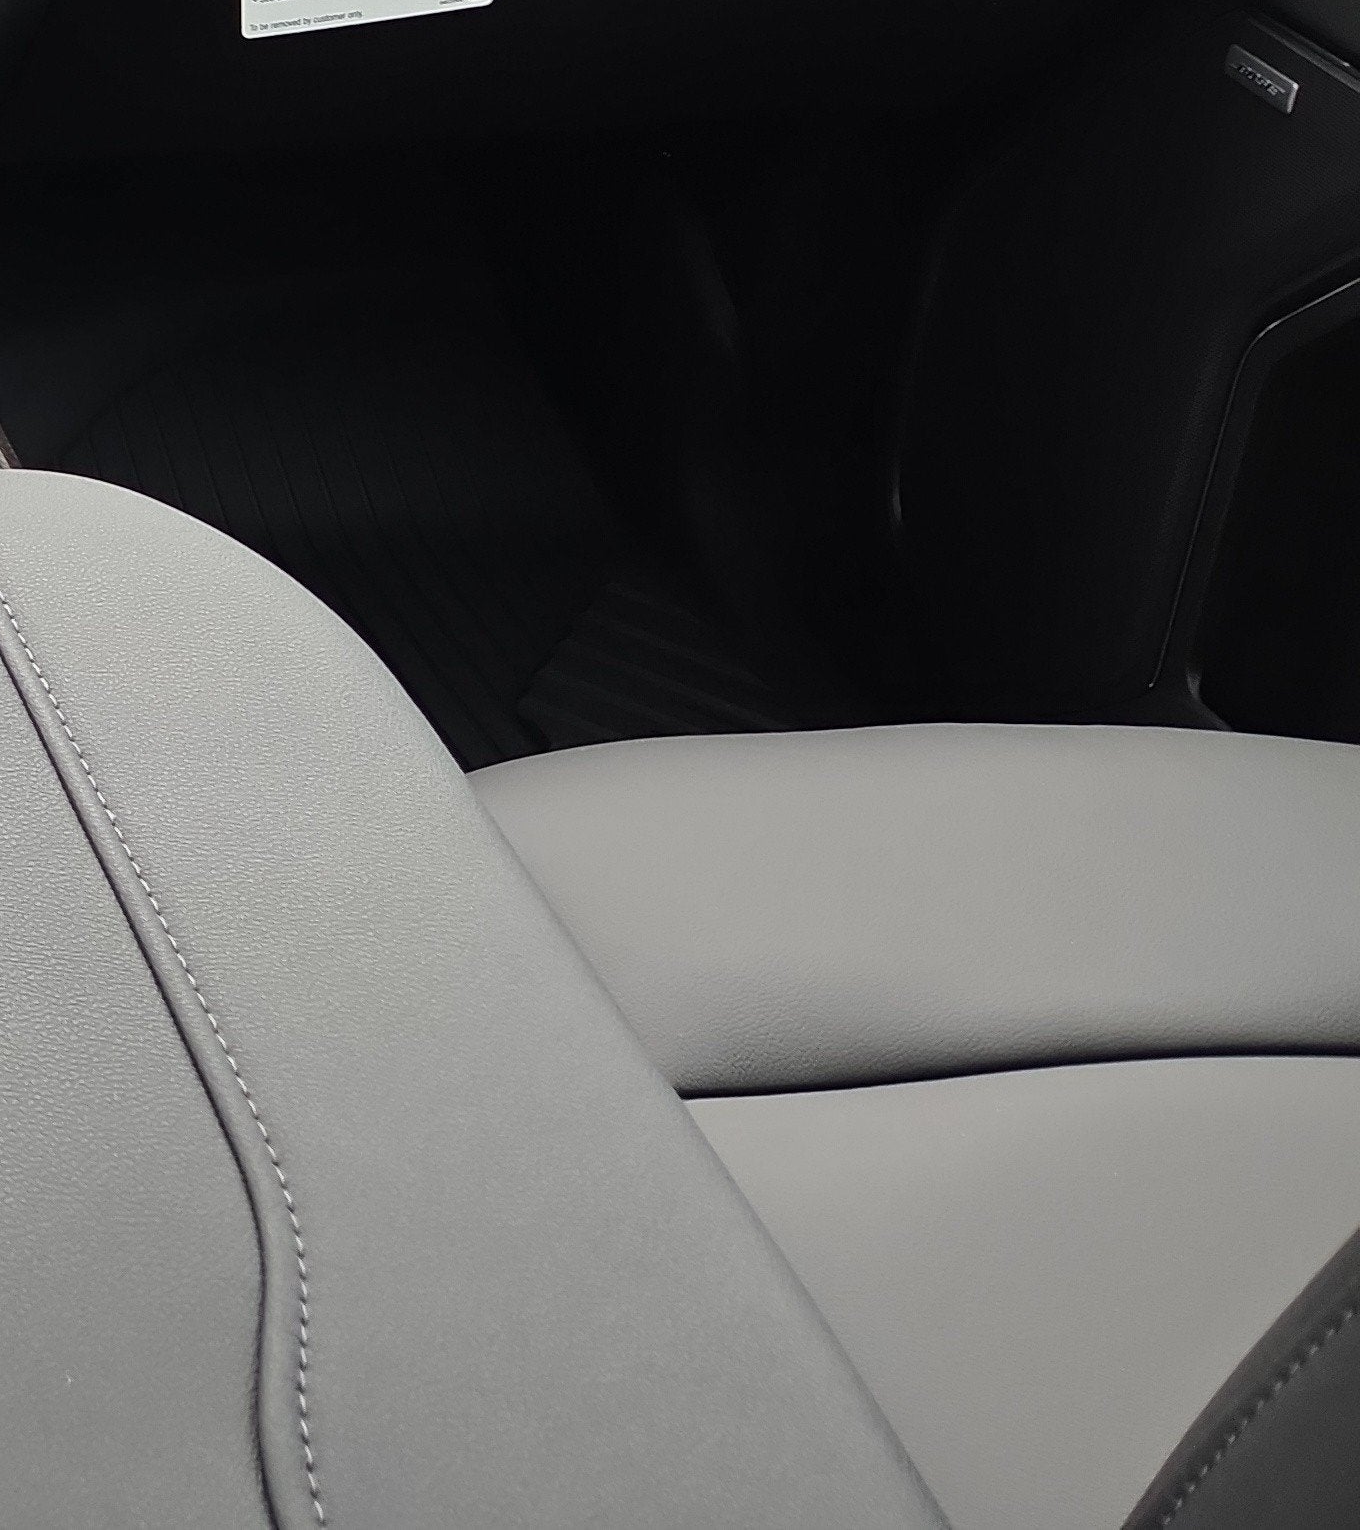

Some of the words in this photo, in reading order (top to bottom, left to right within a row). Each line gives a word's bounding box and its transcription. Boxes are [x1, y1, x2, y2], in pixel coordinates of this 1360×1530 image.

[270, 19, 302, 29] removed
[302, 17, 311, 25] by
[312, 13, 346, 23] customer
